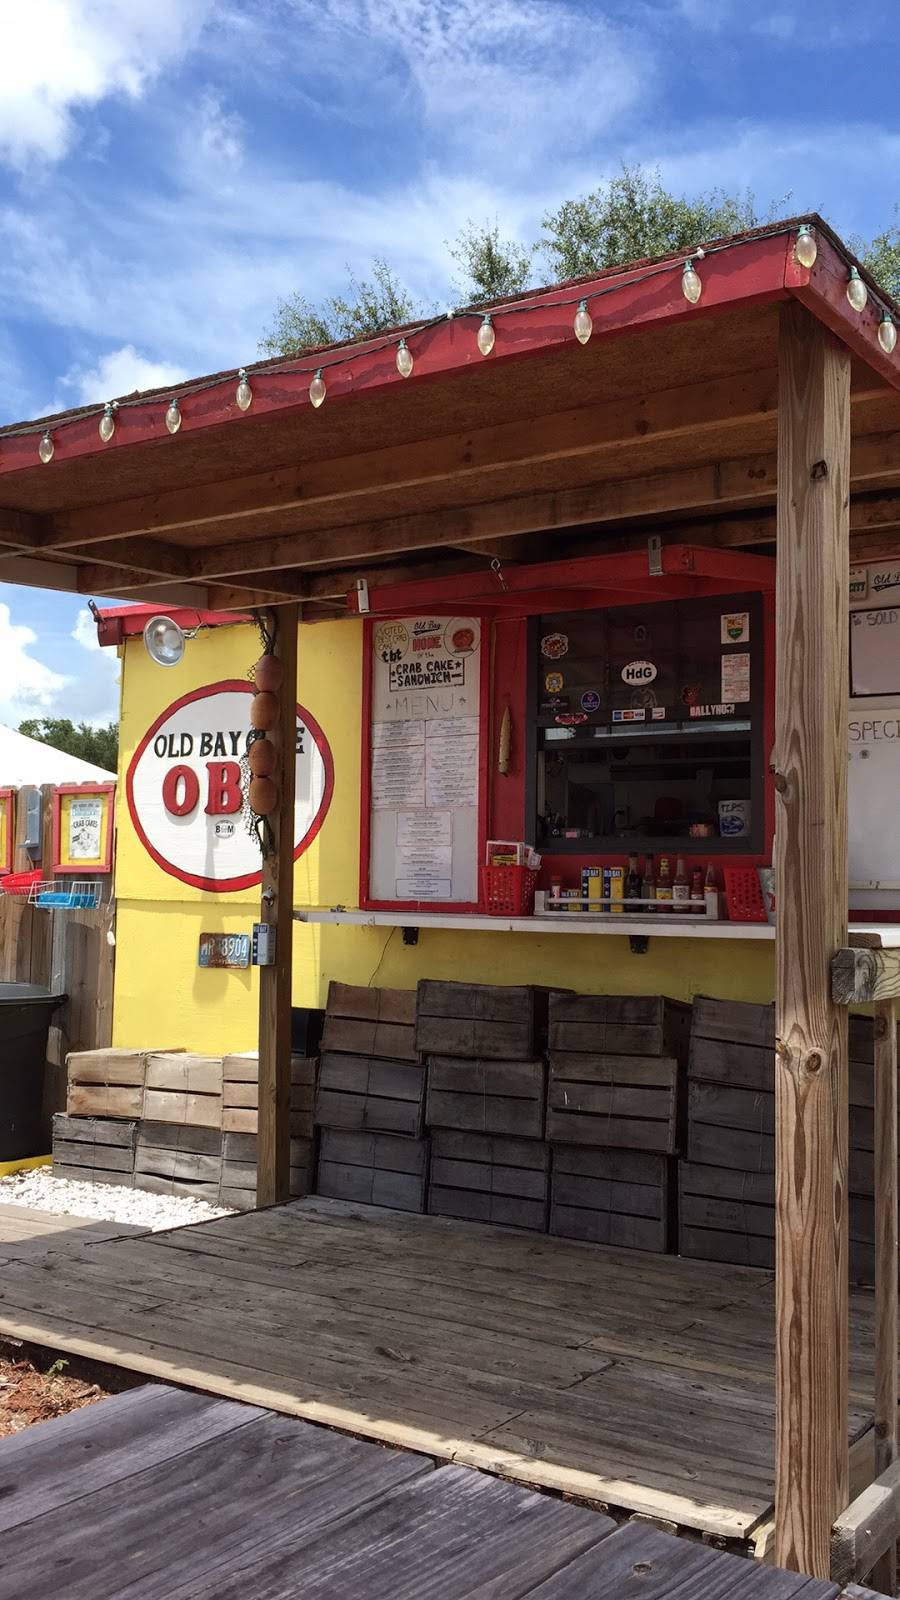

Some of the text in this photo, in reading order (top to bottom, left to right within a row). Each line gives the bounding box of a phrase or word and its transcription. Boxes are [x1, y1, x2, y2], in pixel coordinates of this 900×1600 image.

[873, 573, 891, 585] Old
[866, 611, 897, 626] SOLD
[395, 660, 454, 676] CRAB CAKE
[626, 667, 652, 680] HdG
[397, 672, 451, 687] SANDWICH
[394, 693, 455, 714] MENU
[153, 733, 194, 758] OLD
[199, 731, 243, 757] BAY
